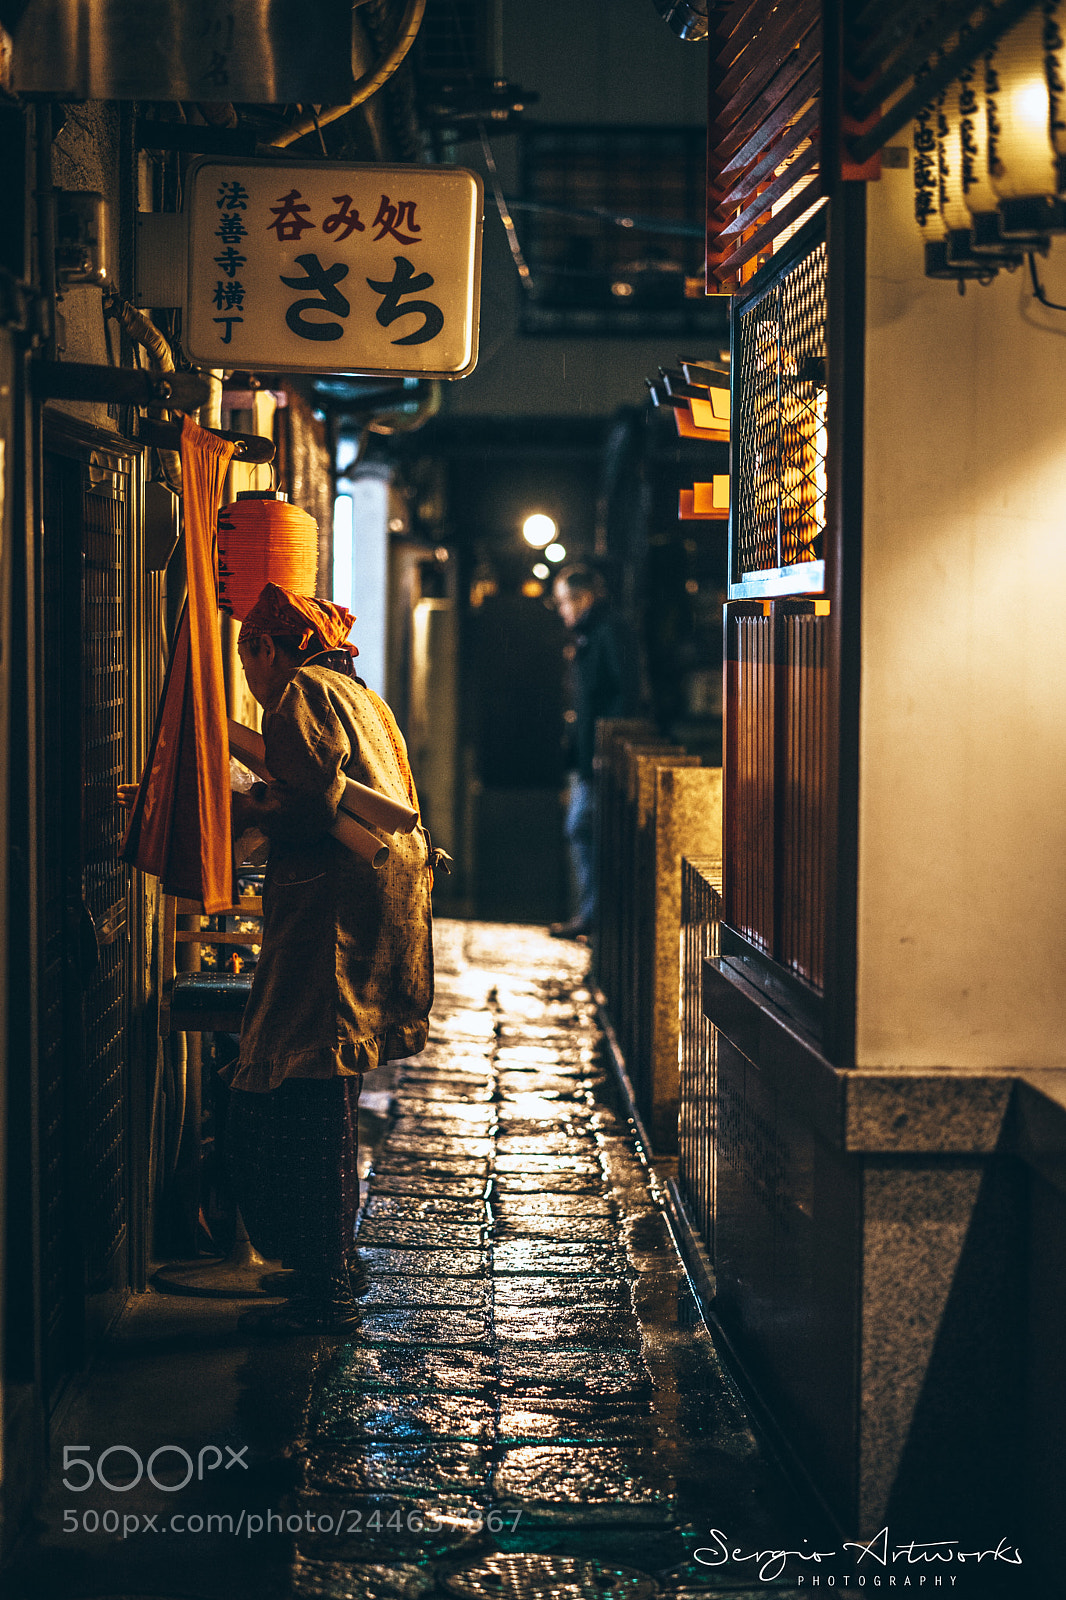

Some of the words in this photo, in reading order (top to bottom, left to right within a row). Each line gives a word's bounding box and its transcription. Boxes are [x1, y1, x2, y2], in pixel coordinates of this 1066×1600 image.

[212, 181, 249, 344] 法善寺横丁
[266, 189, 422, 245] 呑み処
[279, 253, 444, 345] さち
